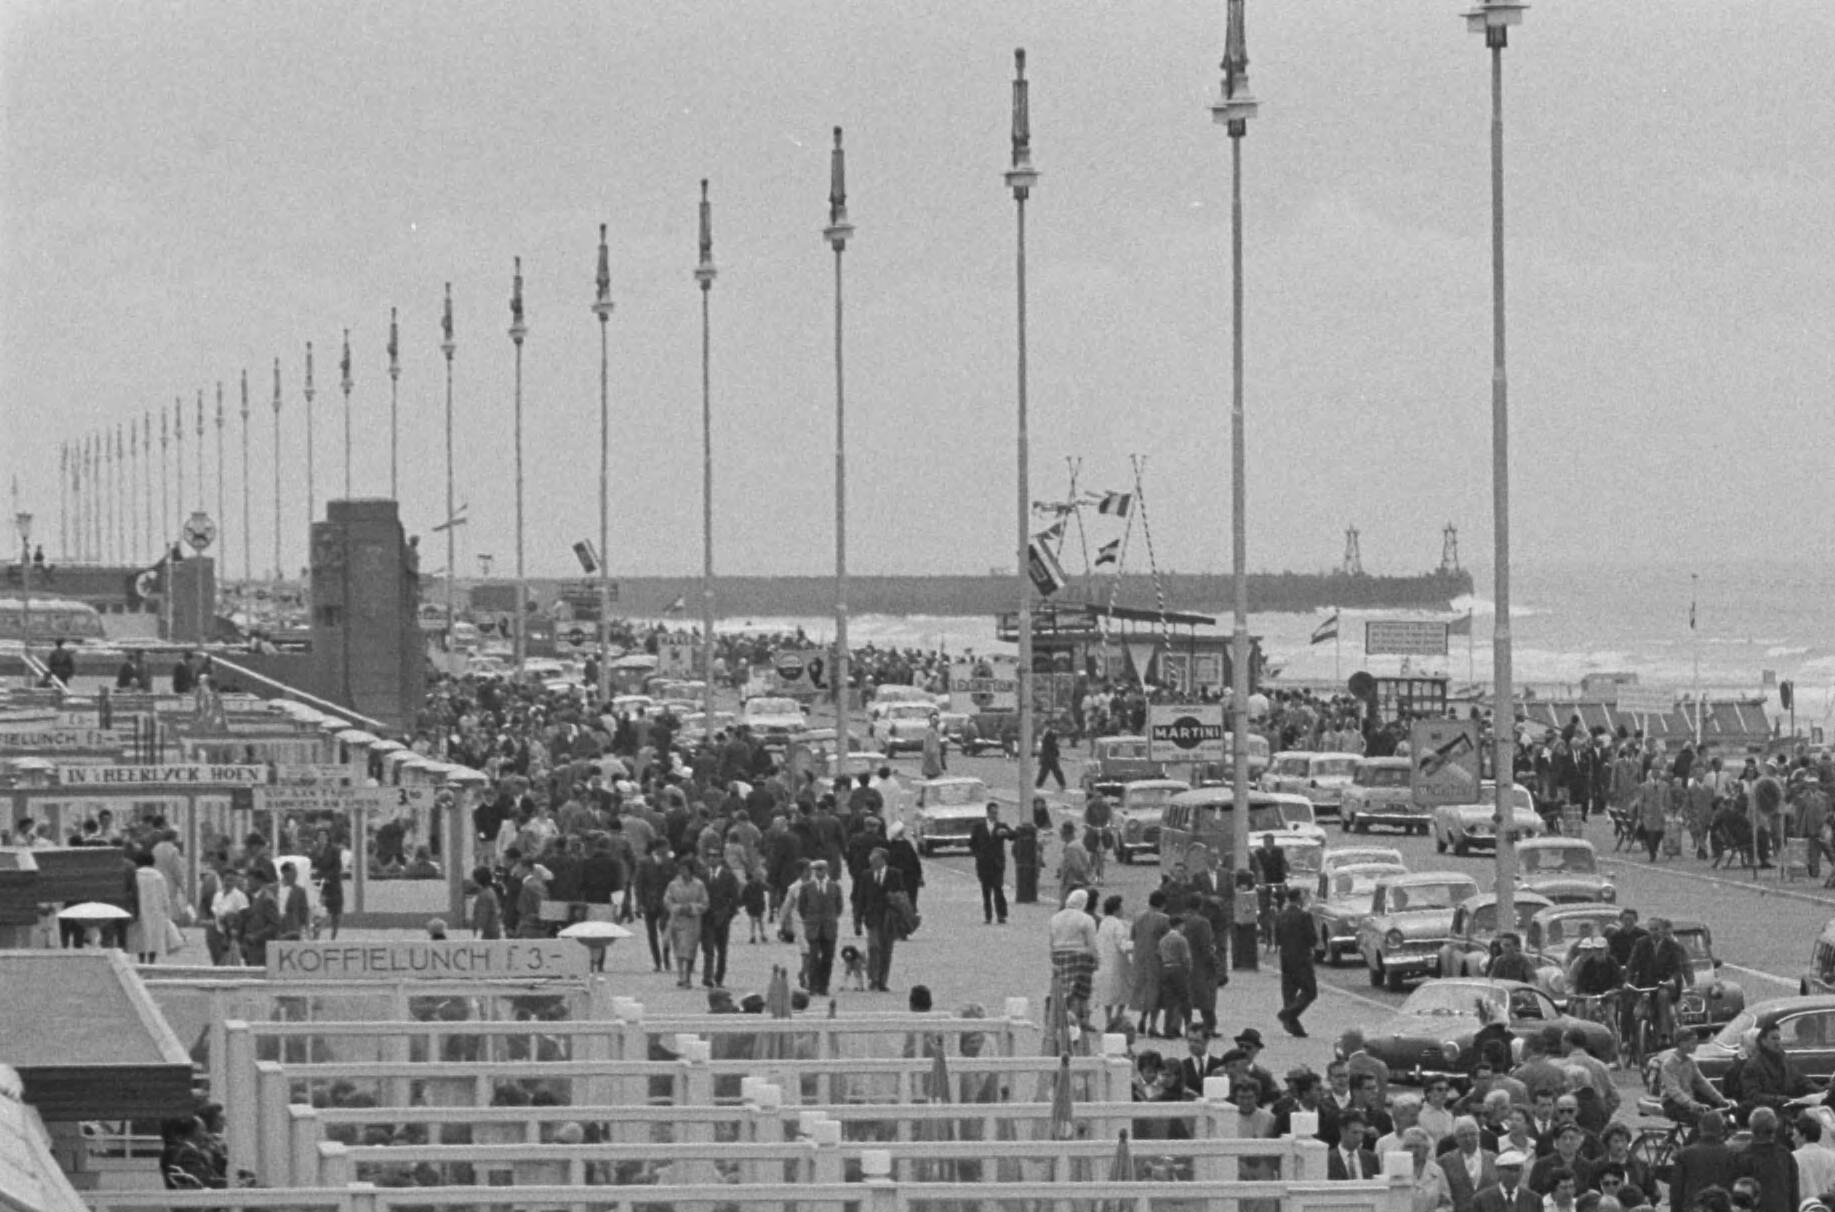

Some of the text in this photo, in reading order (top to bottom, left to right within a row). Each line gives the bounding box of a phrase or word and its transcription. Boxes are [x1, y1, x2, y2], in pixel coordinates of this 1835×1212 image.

[1155, 726, 1220, 739] MARTINI
[67, 768, 86, 782] IN
[278, 947, 490, 972] KOFFIELUNCH
